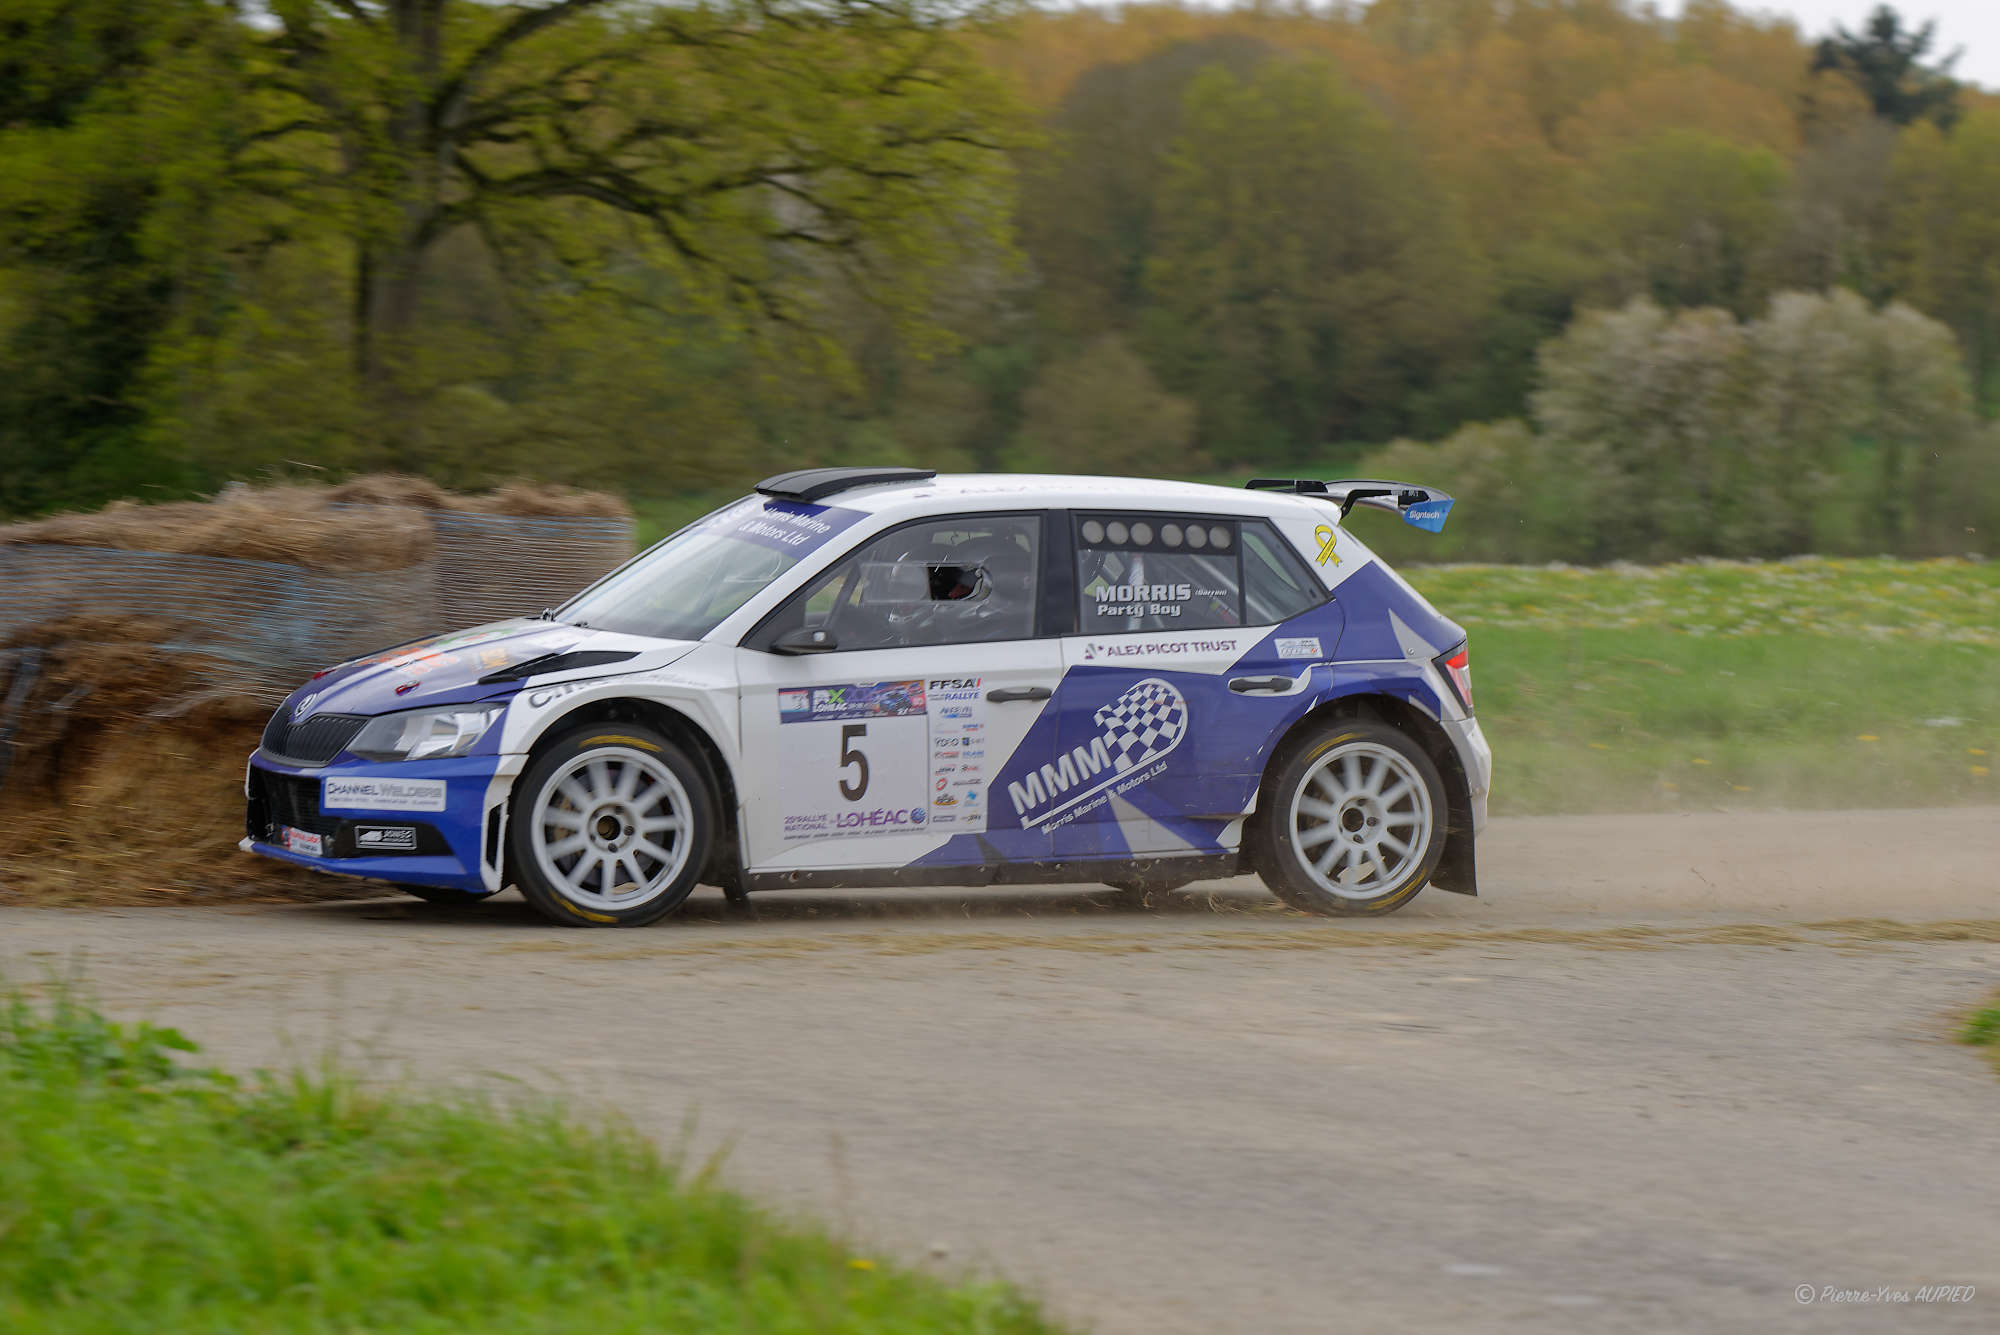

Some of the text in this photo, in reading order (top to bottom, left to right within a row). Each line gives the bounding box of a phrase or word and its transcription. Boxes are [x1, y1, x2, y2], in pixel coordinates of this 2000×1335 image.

[789, 513, 832, 534] Marine
[1409, 510, 1440, 520] Signtech
[781, 530, 811, 546] Ltd
[1095, 583, 1191, 602] MORRIS
[1097, 603, 1181, 617] Party Boy
[1107, 640, 1237, 657] ALEX PICOT TRUST
[929, 678, 975, 689] FFSA
[945, 692, 979, 700] RALLYE
[839, 724, 869, 801] 5
[1008, 736, 1111, 815] MMM
[327, 783, 379, 795] CHANNEL
[1041, 813, 1074, 834] Morris
[1073, 794, 1107, 817] Marine
[1116, 774, 1151, 795] Motors
[1150, 761, 1168, 778] Ltd
[836, 808, 908, 827] LOHÉAC
